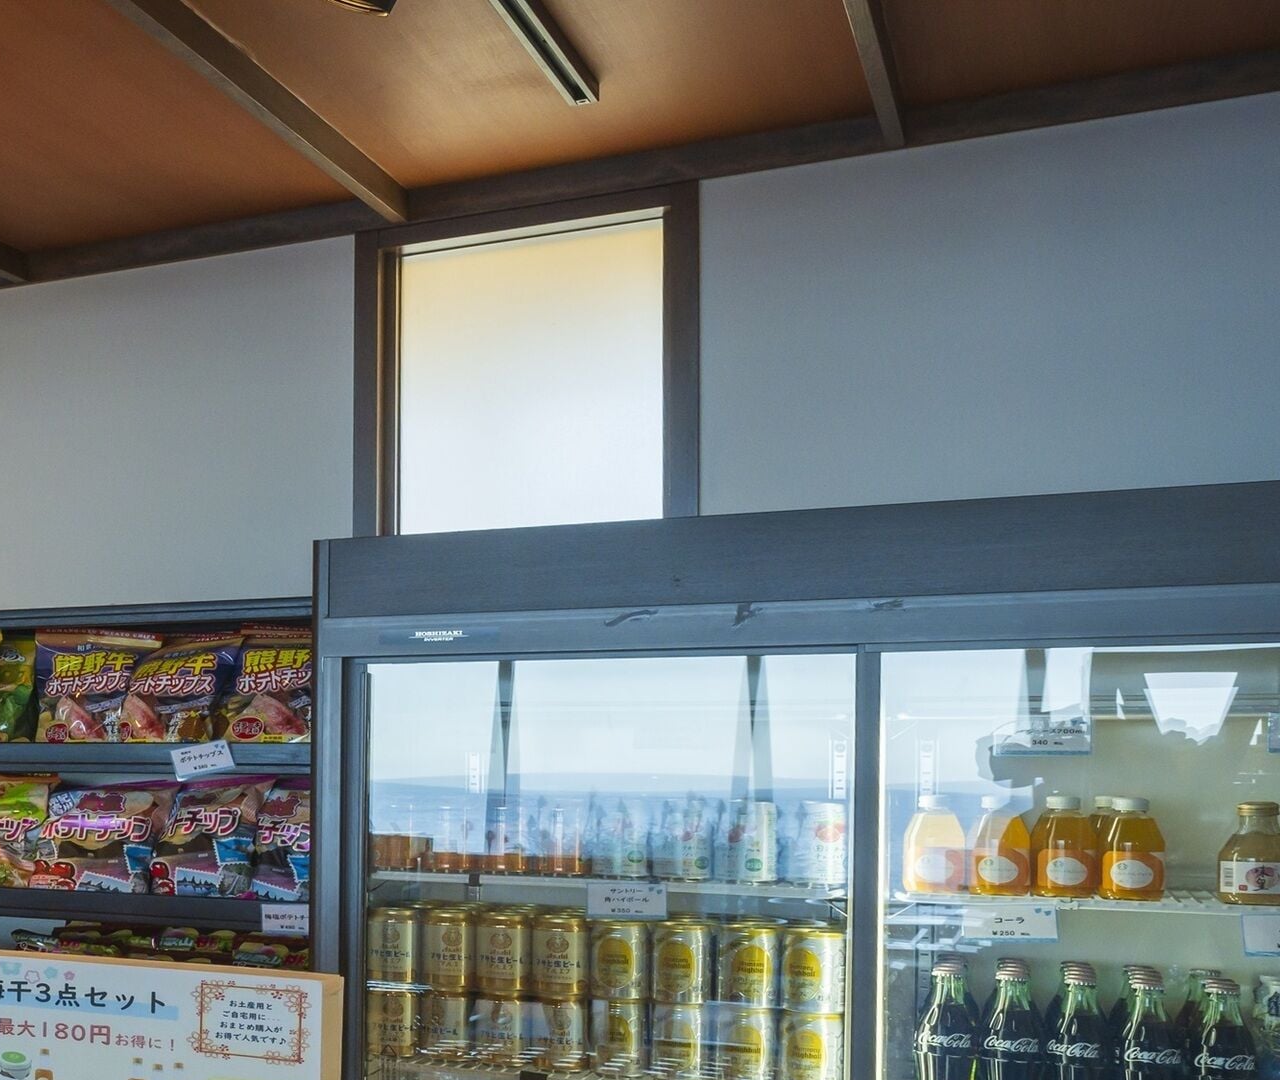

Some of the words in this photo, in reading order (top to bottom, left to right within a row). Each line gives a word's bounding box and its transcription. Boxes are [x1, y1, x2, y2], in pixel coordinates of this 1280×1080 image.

[53, 651, 137, 678] 熊野牛
[994, 916, 1025, 925] コーラ
[229, 1000, 273, 1010] お土産用と
[220, 1021, 283, 1034] おまとめ購入が
